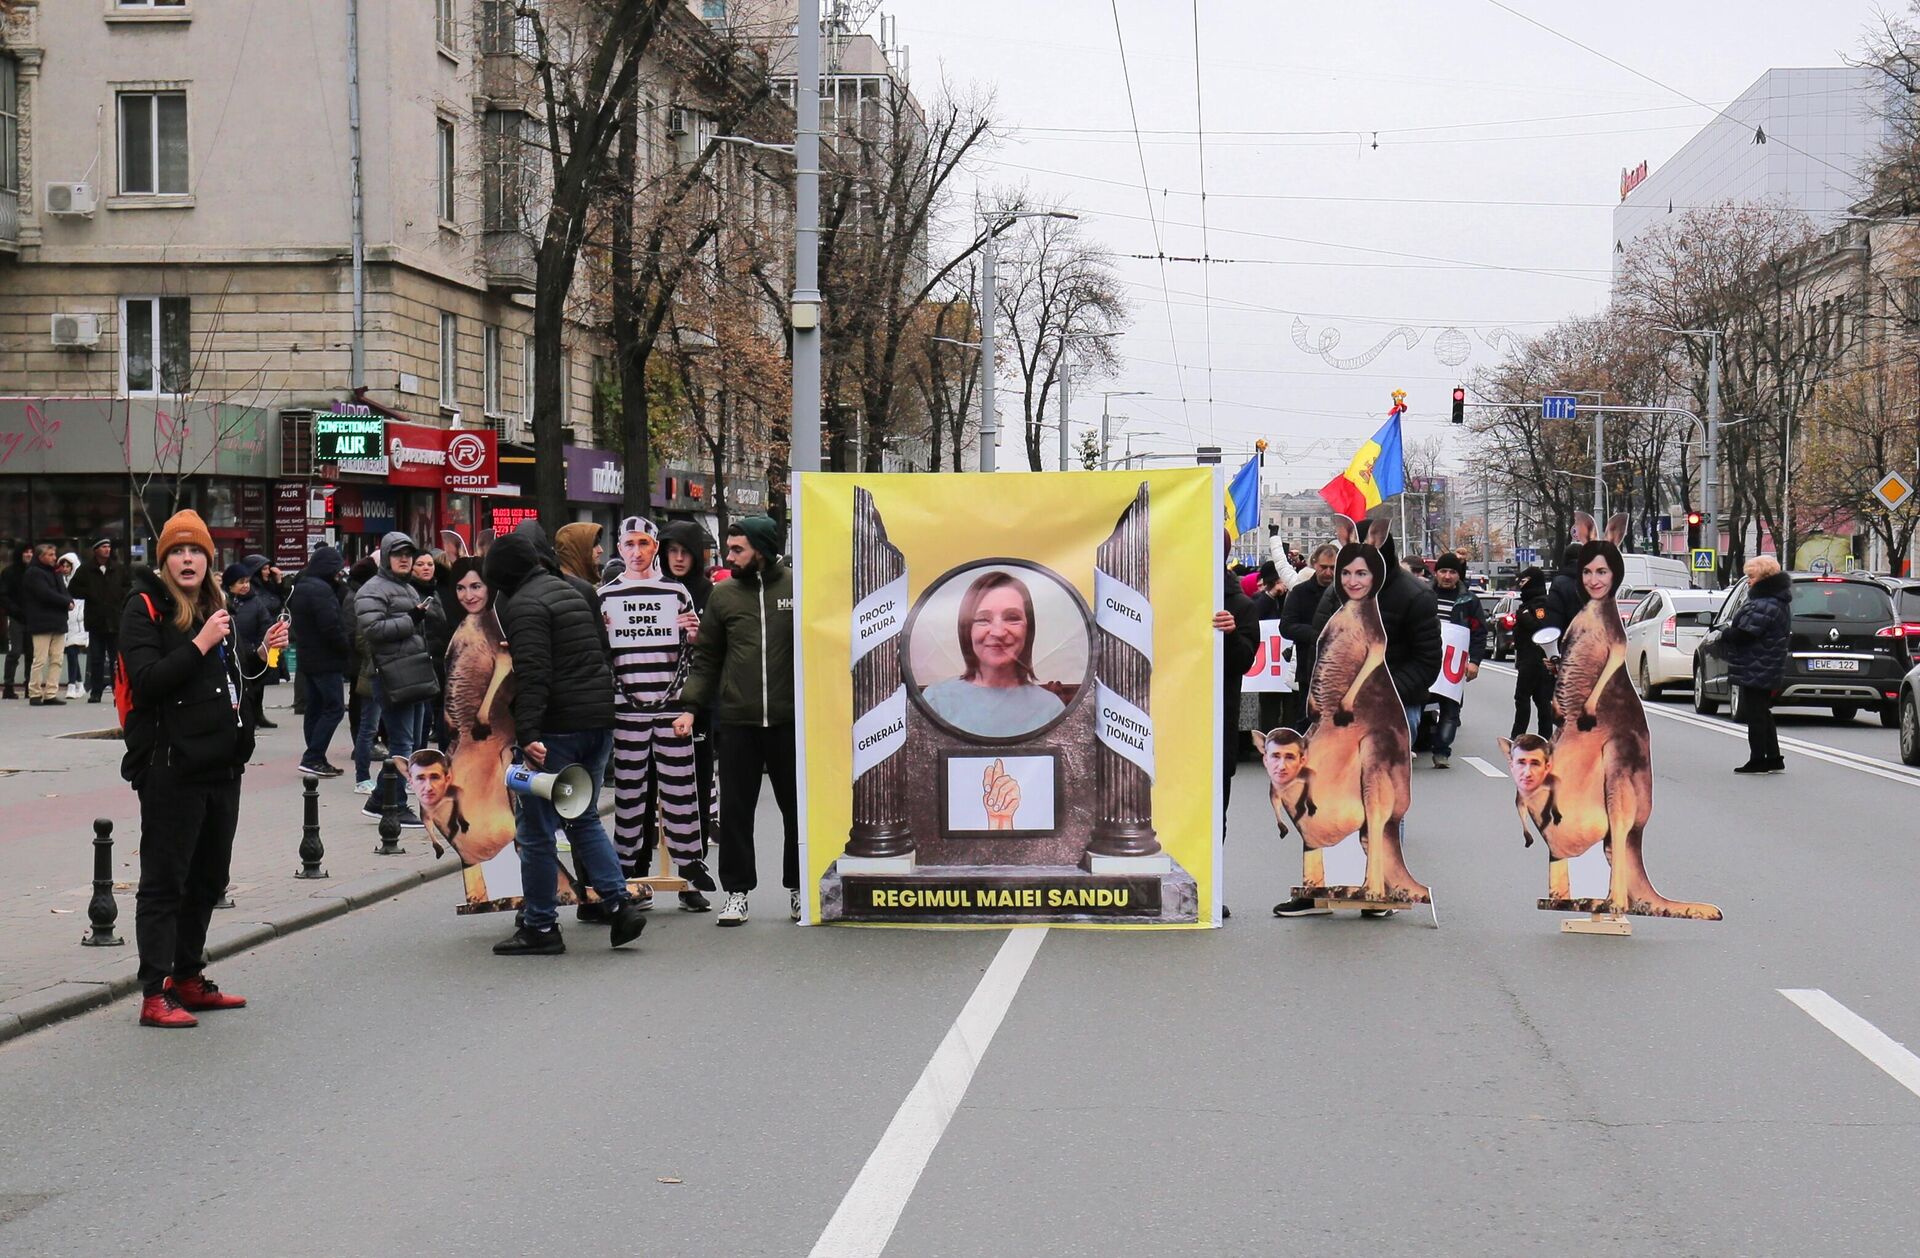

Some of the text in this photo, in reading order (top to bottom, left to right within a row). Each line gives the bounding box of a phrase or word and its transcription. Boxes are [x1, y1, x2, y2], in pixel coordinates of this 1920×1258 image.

[335, 436, 365, 454] AUR
[444, 475, 490, 485] CREDIT
[281, 490, 298, 498] AUR
[623, 600, 662, 612] ÎN PAS
[859, 600, 896, 625] PROCU-
[1106, 597, 1142, 623] CURTEA
[628, 615, 657, 624] SPRE
[860, 615, 896, 640] RATURA
[615, 626, 672, 640] PUȘCĂRIE
[1815, 660, 1854, 670] EWE 122
[1103, 707, 1152, 738] CONSTITU-
[858, 717, 904, 751] GENERALĂ
[1106, 723, 1145, 751] ȚIONALĂ
[871, 888, 1129, 908] REGIMUL MAIEI SANDU
